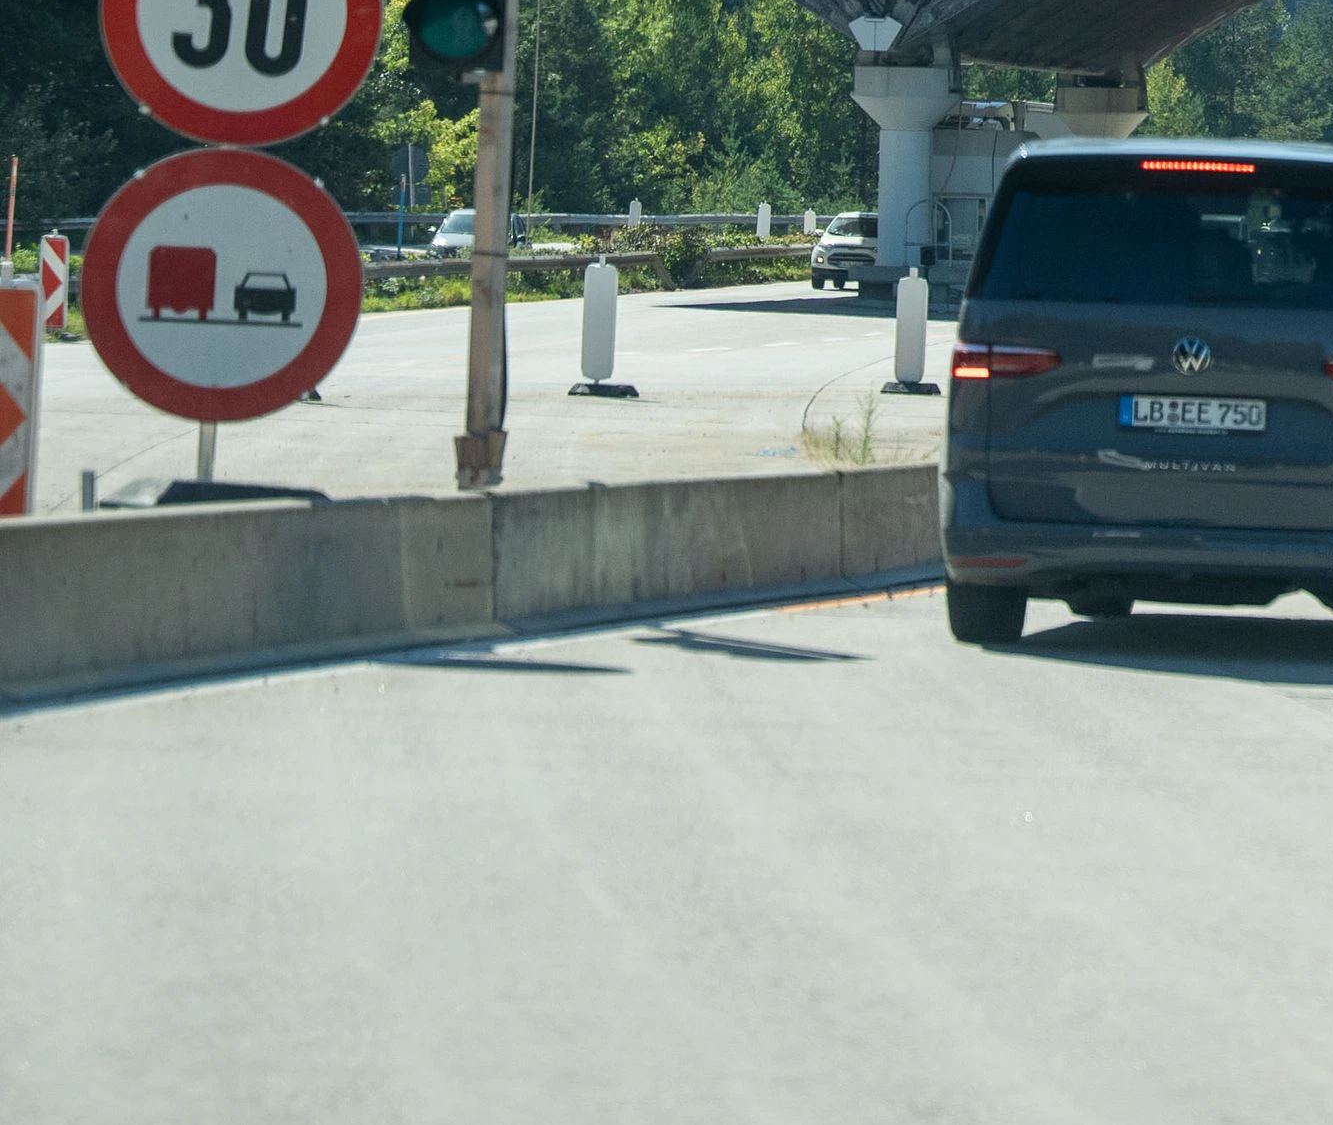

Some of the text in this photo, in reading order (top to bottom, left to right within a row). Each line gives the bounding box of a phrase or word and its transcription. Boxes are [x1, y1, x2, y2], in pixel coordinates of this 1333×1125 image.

[1134, 399, 1263, 426] LB EE 750
